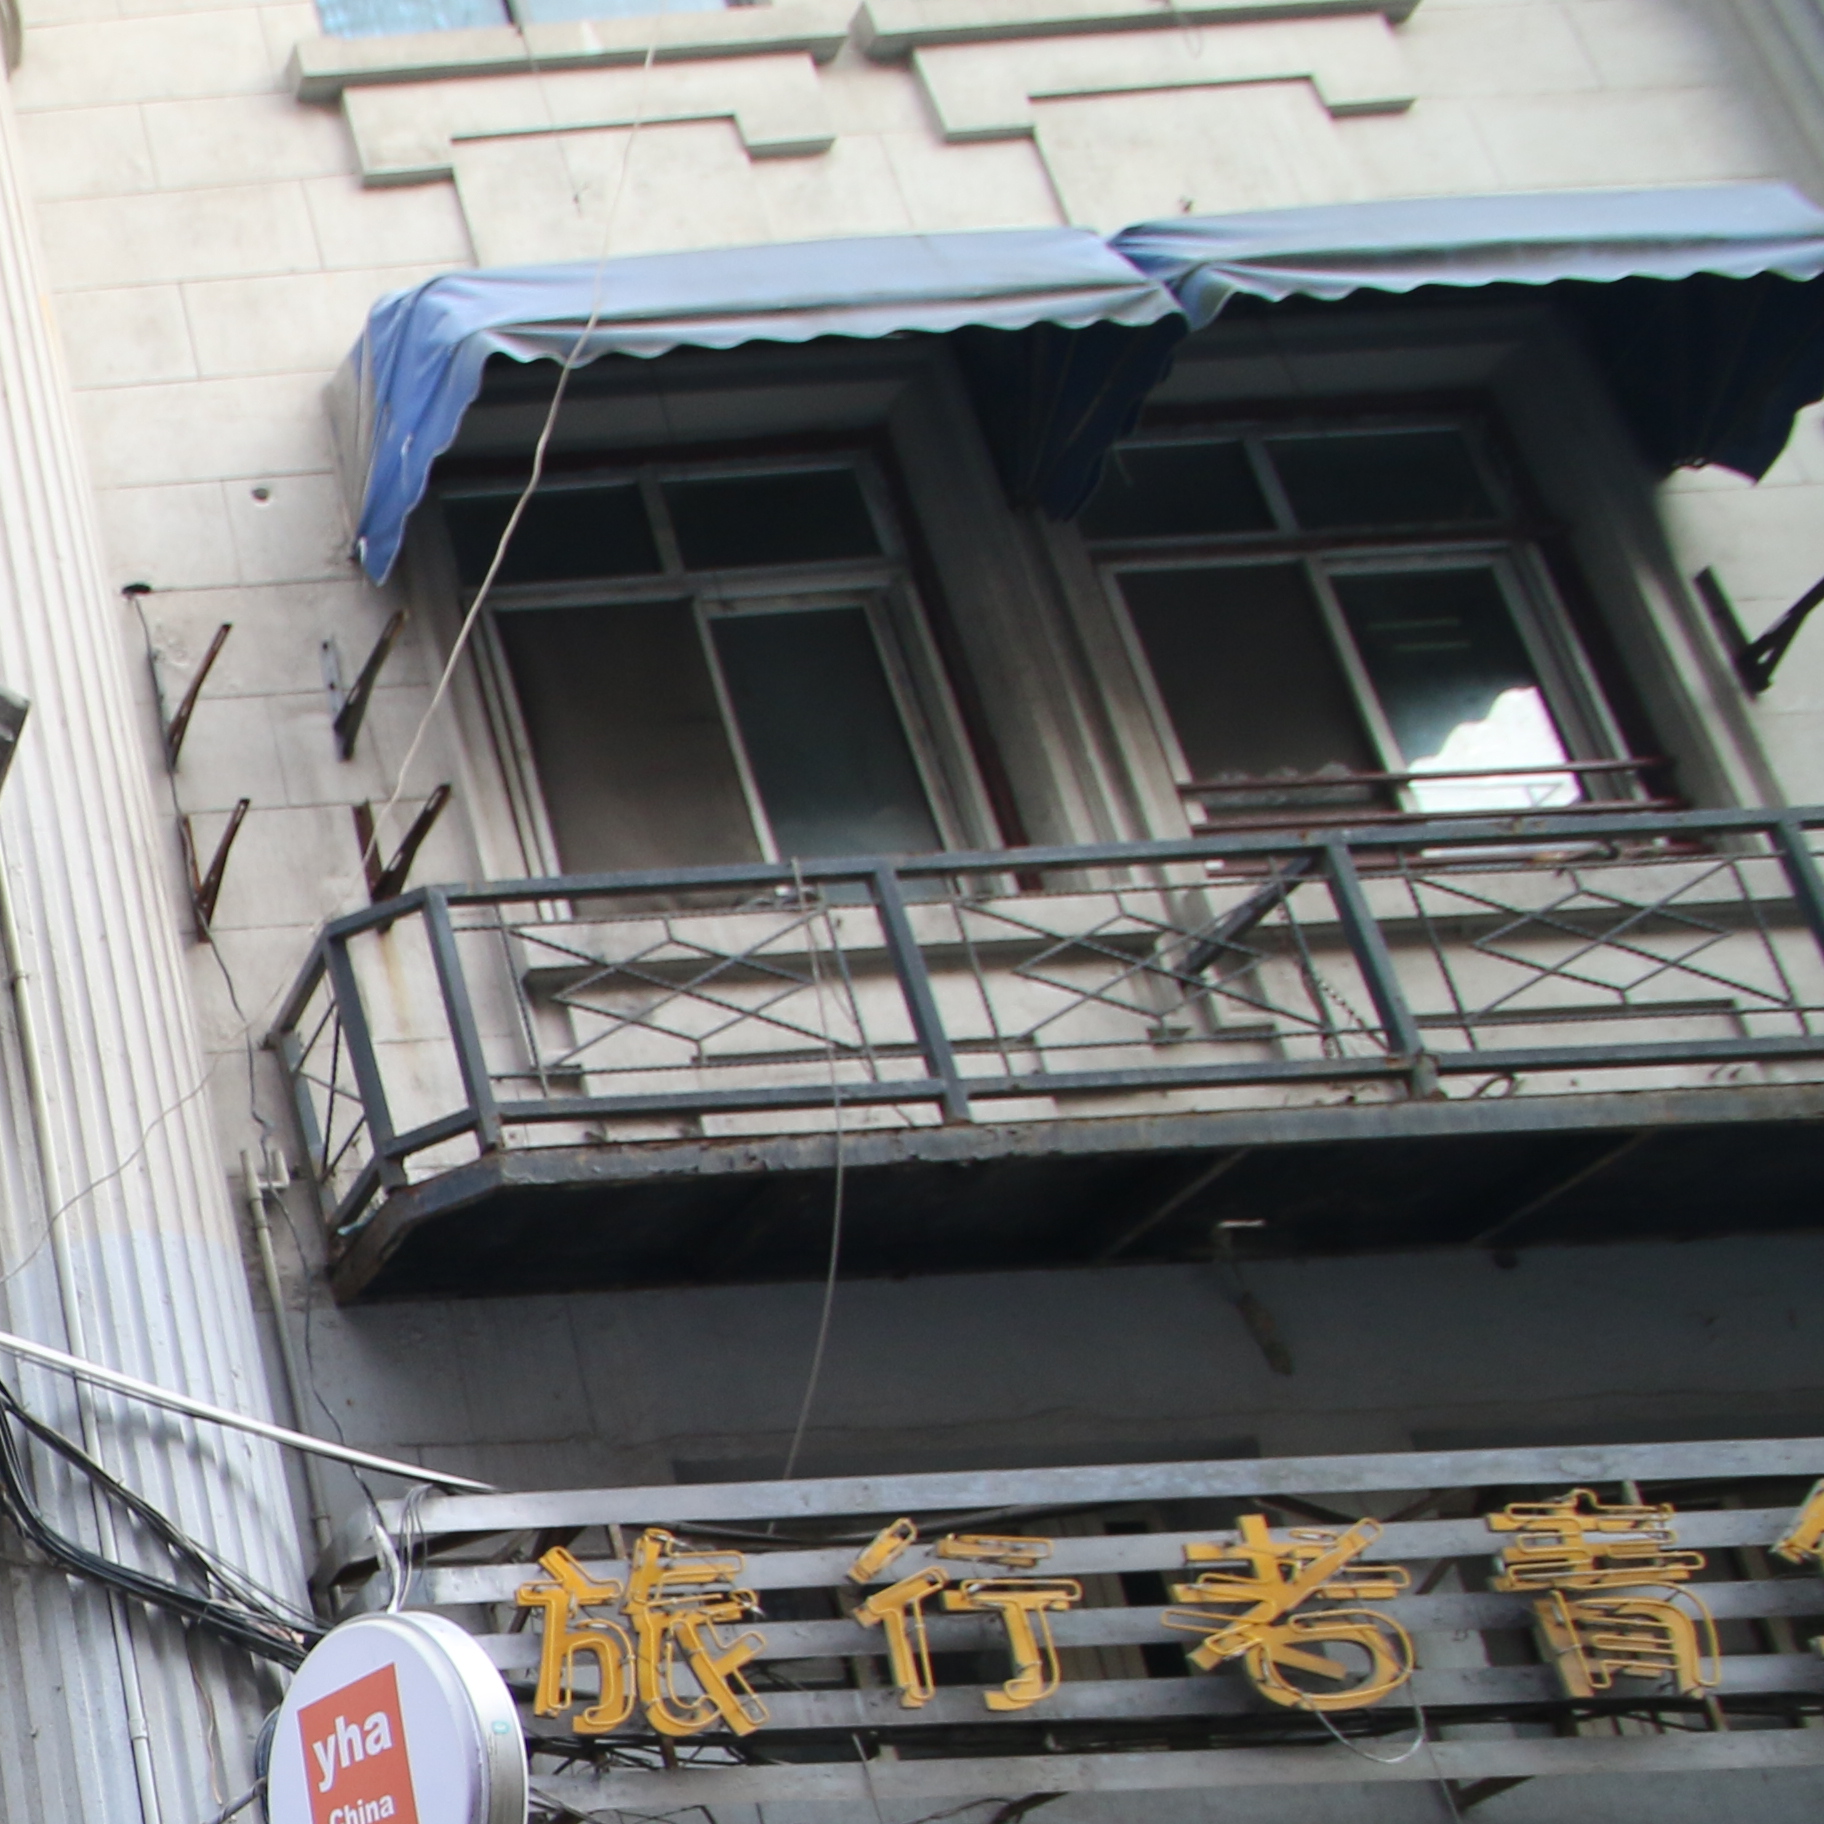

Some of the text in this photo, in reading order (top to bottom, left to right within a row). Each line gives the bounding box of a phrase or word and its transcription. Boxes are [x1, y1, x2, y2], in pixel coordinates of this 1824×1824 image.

[516, 1482, 1824, 1738] 旅行者青
[312, 1711, 393, 1793] yha
